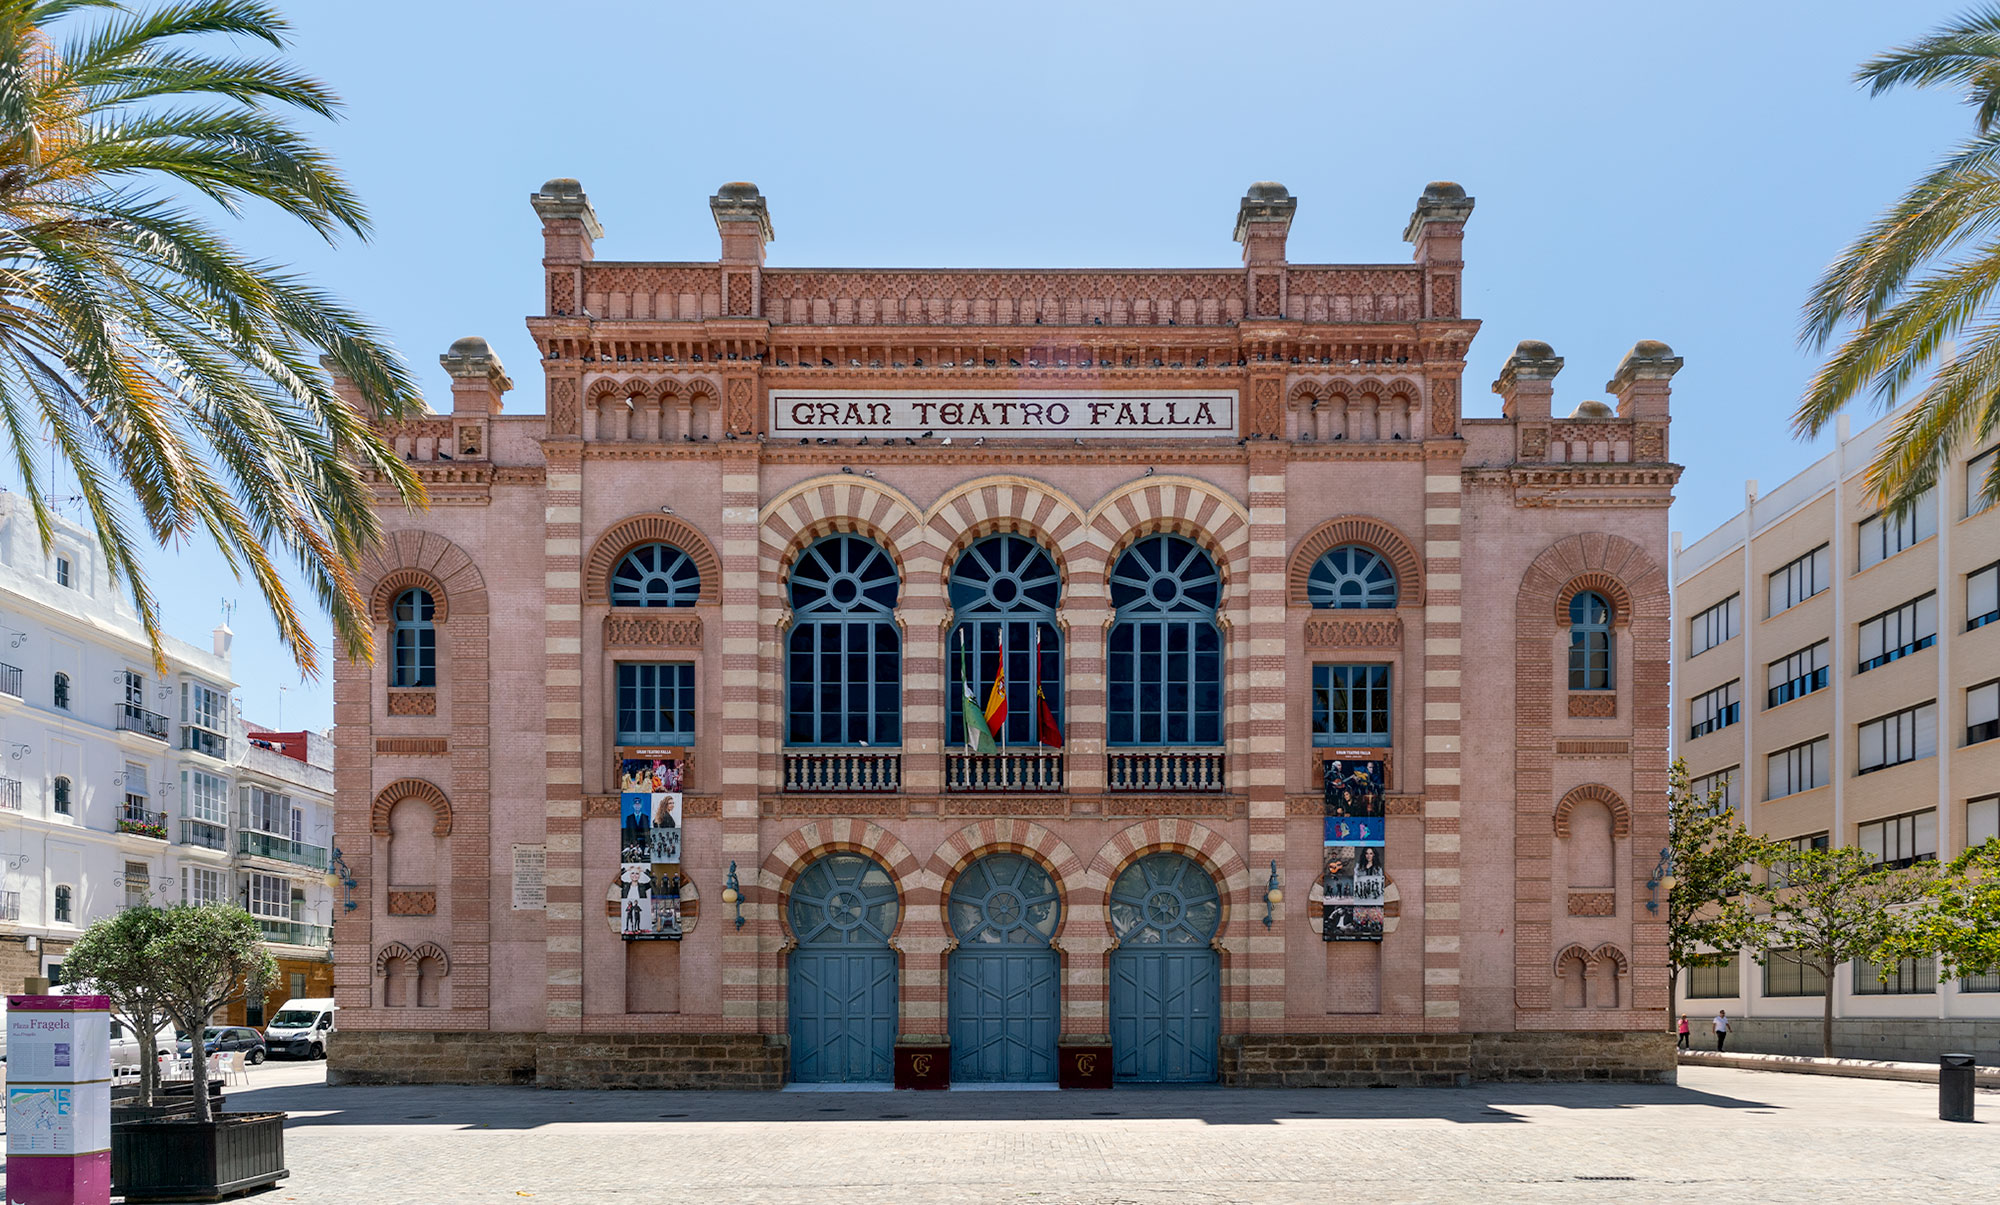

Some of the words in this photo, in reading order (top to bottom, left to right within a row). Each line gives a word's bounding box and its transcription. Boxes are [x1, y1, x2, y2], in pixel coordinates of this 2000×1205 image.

[791, 402, 891, 425] GRAN
[912, 402, 1070, 425] TEATRO
[1087, 402, 1216, 425] FALLA
[30, 1018, 70, 1032] Fragela
